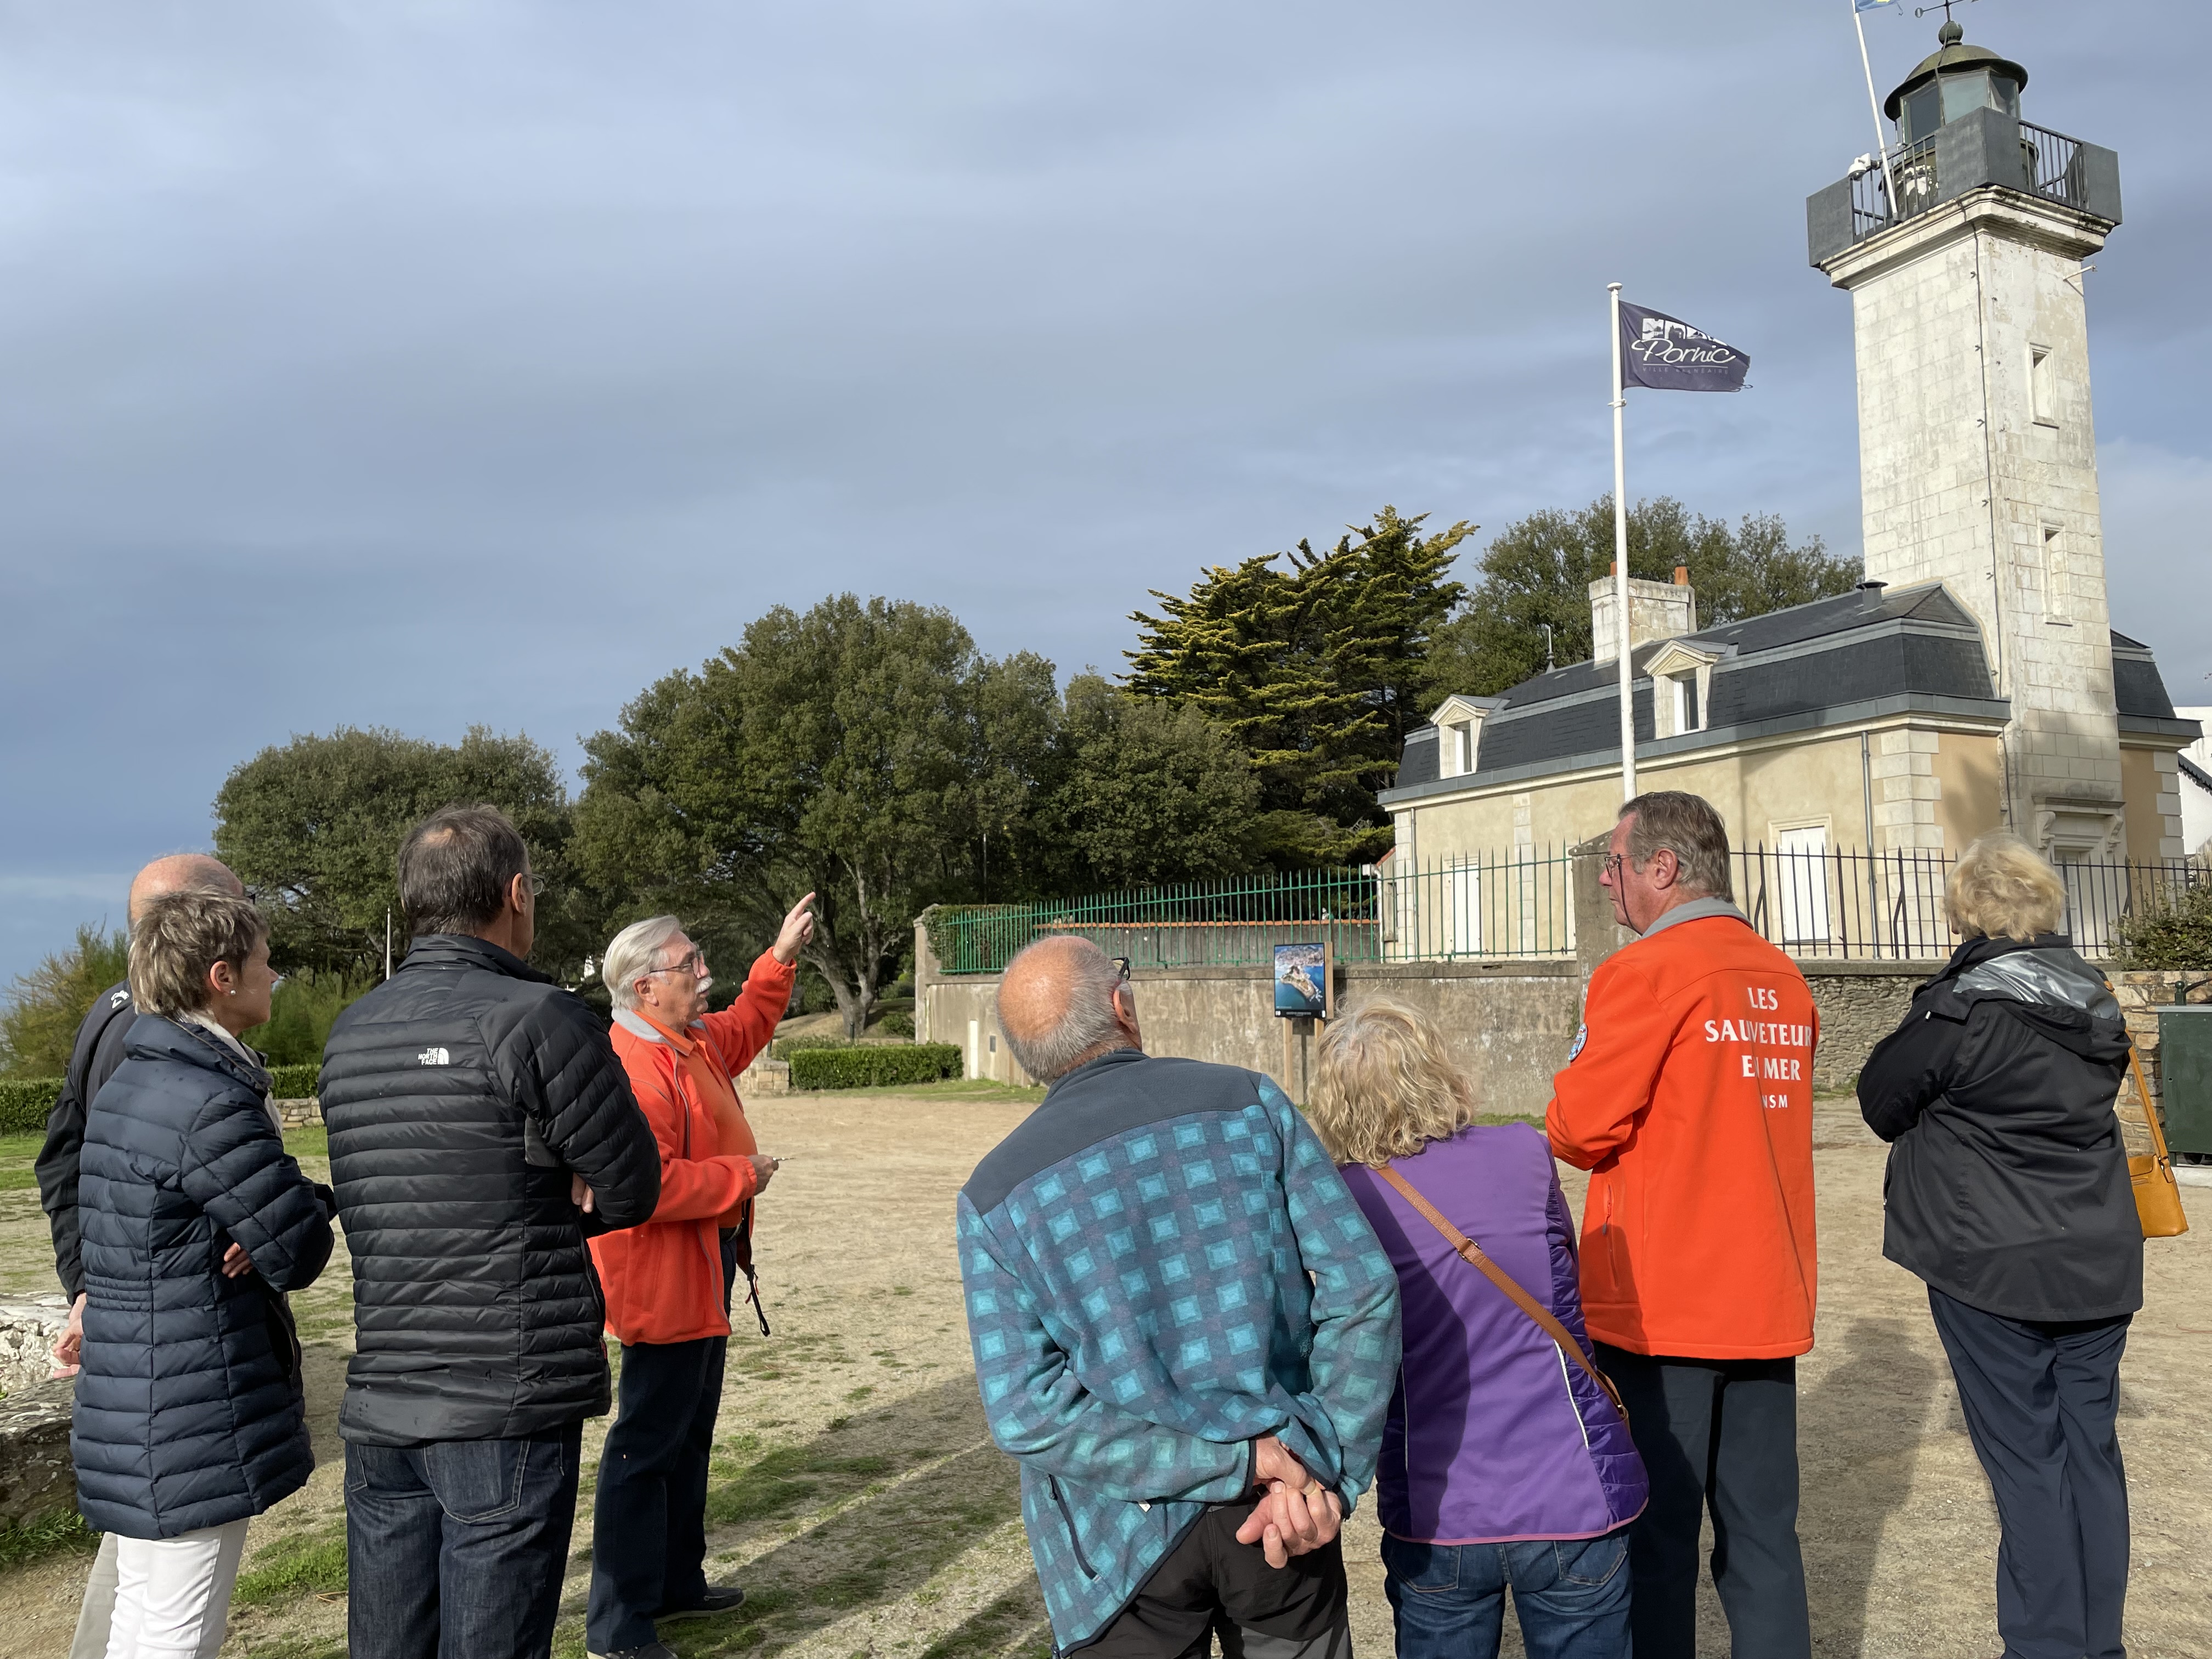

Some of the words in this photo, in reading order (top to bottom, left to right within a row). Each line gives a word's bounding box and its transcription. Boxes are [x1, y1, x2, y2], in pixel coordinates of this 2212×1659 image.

[1631, 337, 1736, 363] Pornic
[1747, 988, 1779, 1011] LES
[1764, 1058, 1802, 1081] MER
